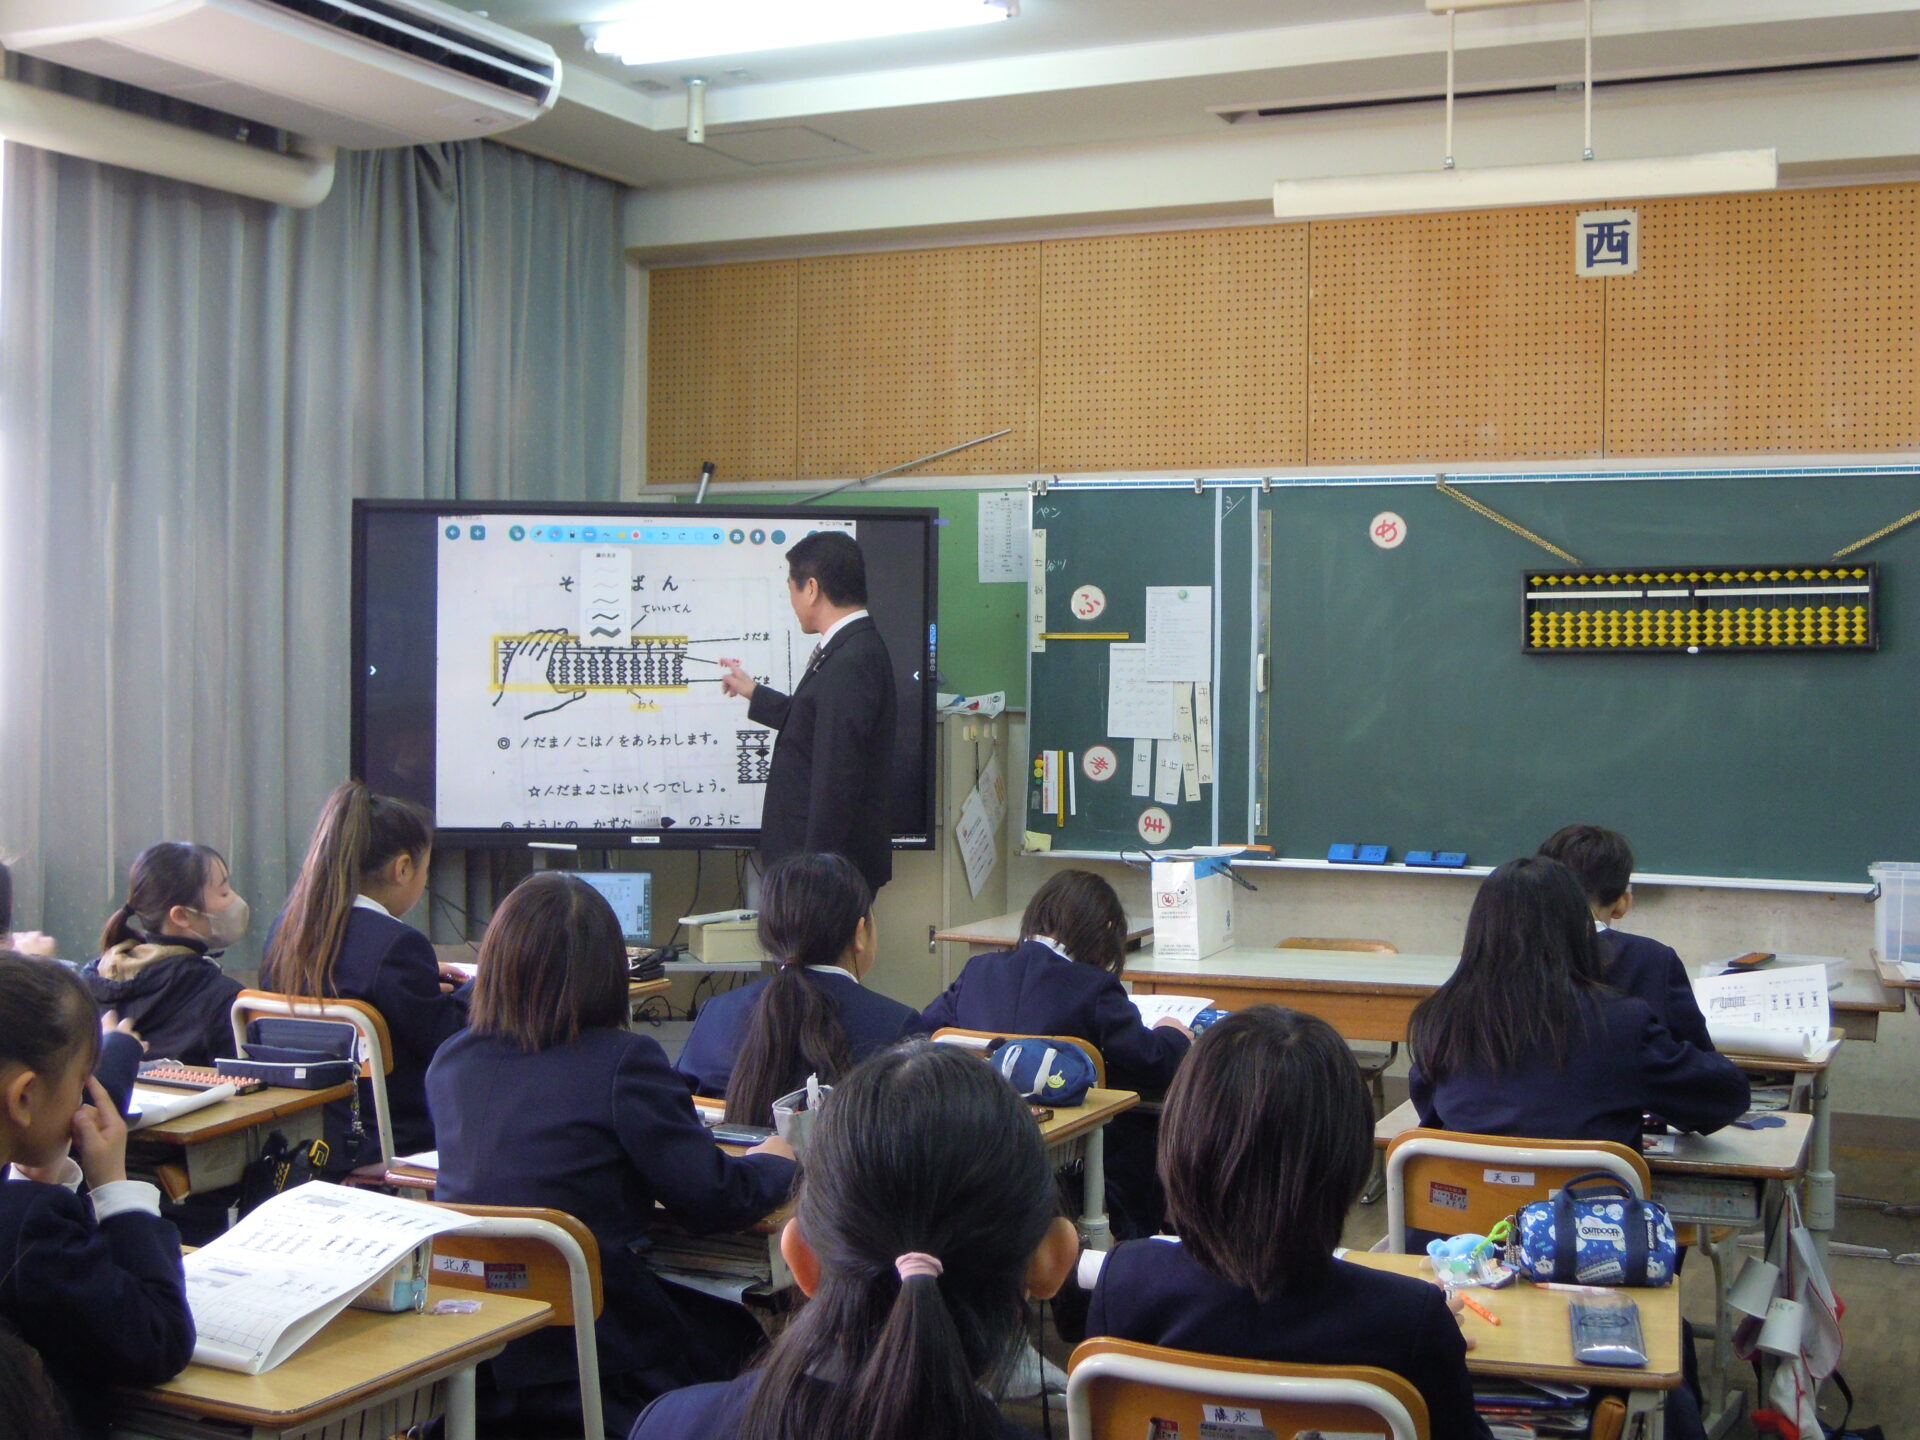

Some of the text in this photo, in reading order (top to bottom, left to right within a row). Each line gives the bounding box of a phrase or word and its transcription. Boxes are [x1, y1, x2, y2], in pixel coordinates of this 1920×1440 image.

[1583, 219, 1632, 268] 西
[1375, 519, 1397, 542] め
[1080, 593, 1101, 615] ふ
[689, 814, 741, 826] のように
[443, 1258, 473, 1273] 北原
